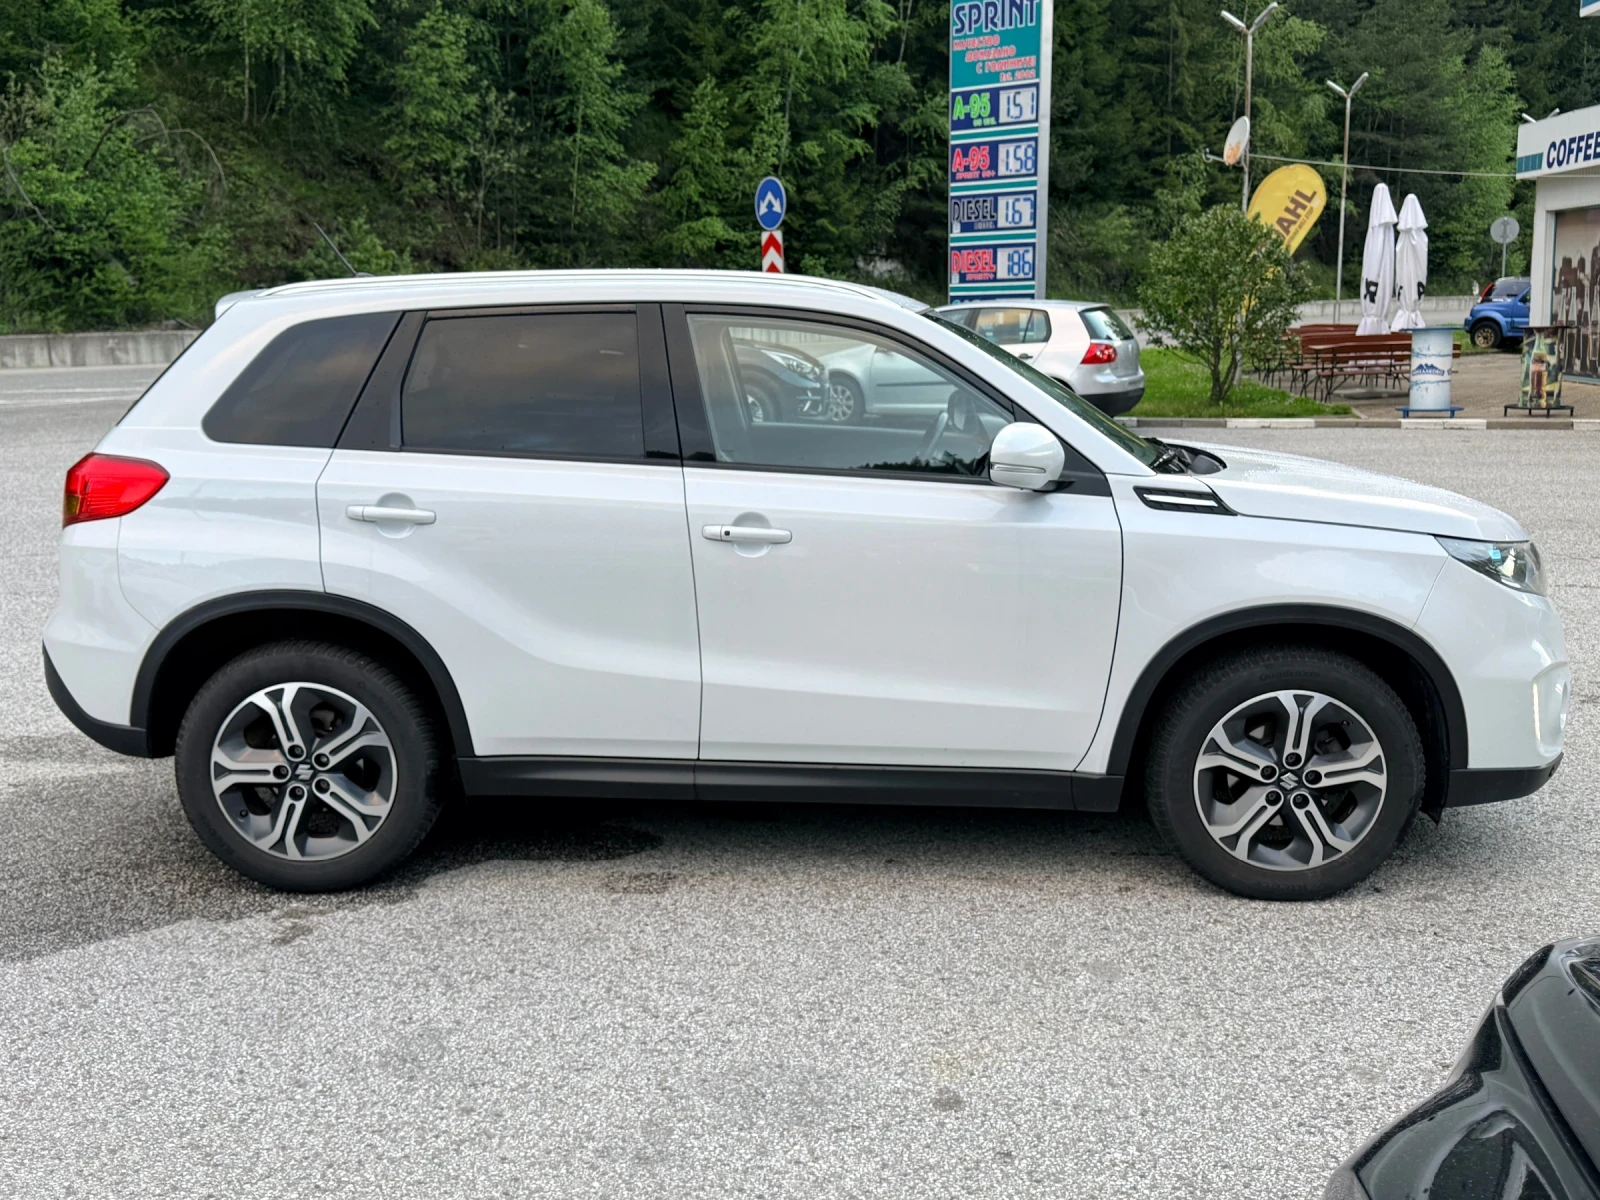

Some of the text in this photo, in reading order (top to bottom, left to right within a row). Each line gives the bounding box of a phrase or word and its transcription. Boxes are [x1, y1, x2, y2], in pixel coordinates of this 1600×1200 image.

[953, 0, 1037, 36] SPRINT
[952, 92, 991, 120] A-95
[952, 145, 1035, 173] A-95 1.58
[1546, 131, 1600, 169] COFFEE
[951, 197, 997, 222] DIESEL
[951, 249, 996, 273] DIESEL
